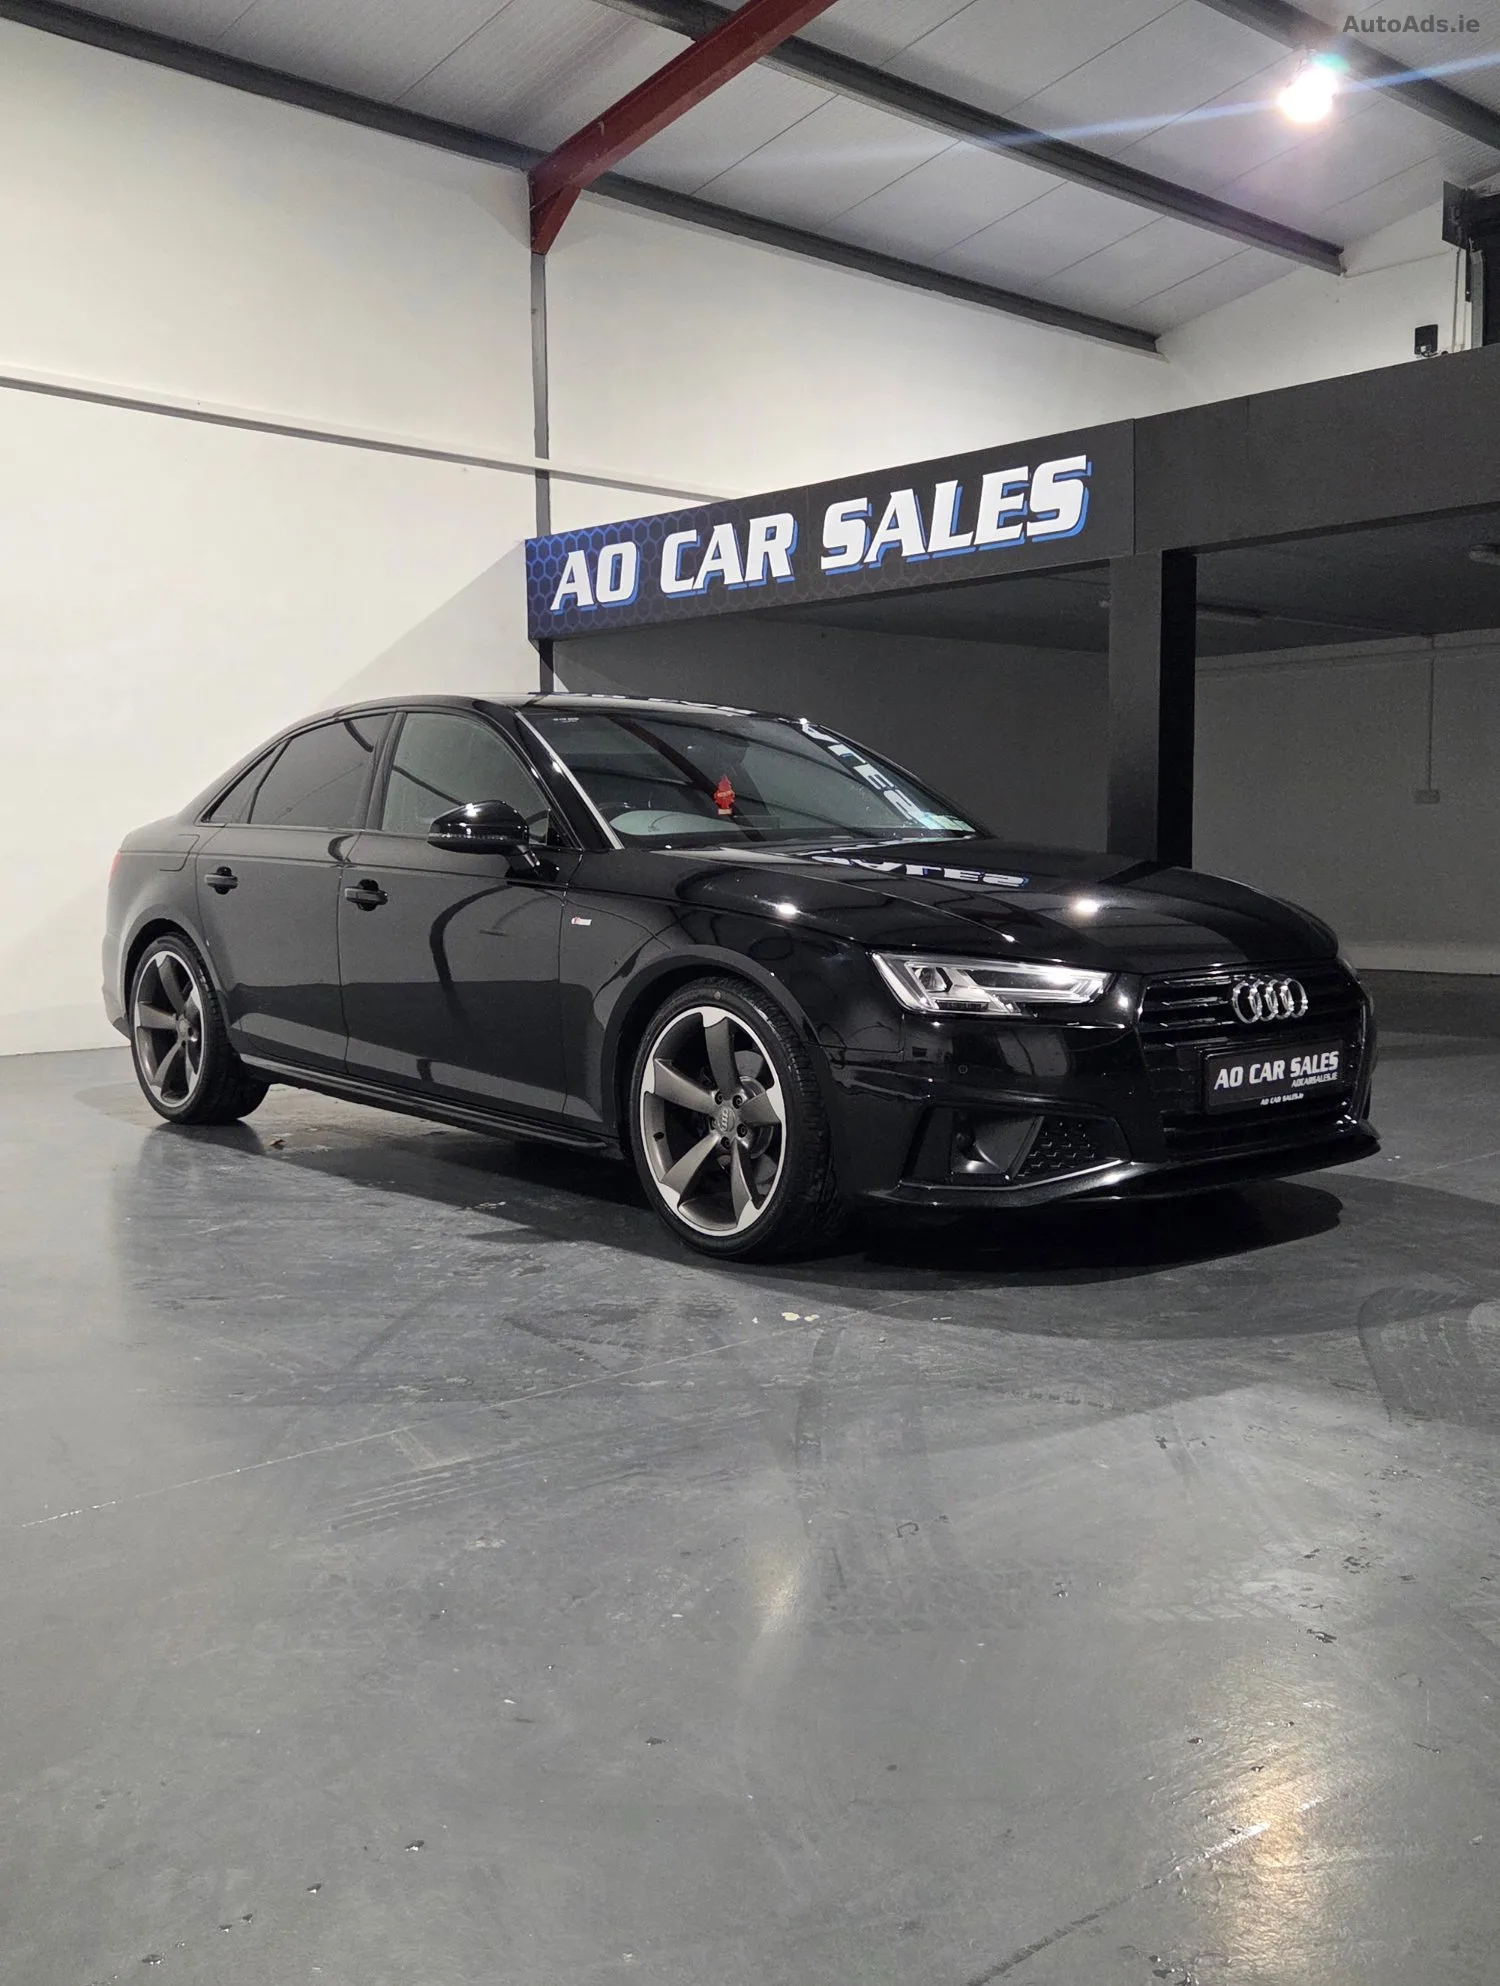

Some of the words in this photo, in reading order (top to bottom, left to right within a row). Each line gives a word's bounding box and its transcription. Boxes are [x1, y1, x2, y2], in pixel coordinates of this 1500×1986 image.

[550, 540, 640, 613] AO
[660, 513, 798, 598] CAR
[820, 455, 1092, 575] SALES
[1213, 1066, 1244, 1090] AO
[1249, 1060, 1286, 1085] CAR
[1290, 1051, 1340, 1078] SALES
